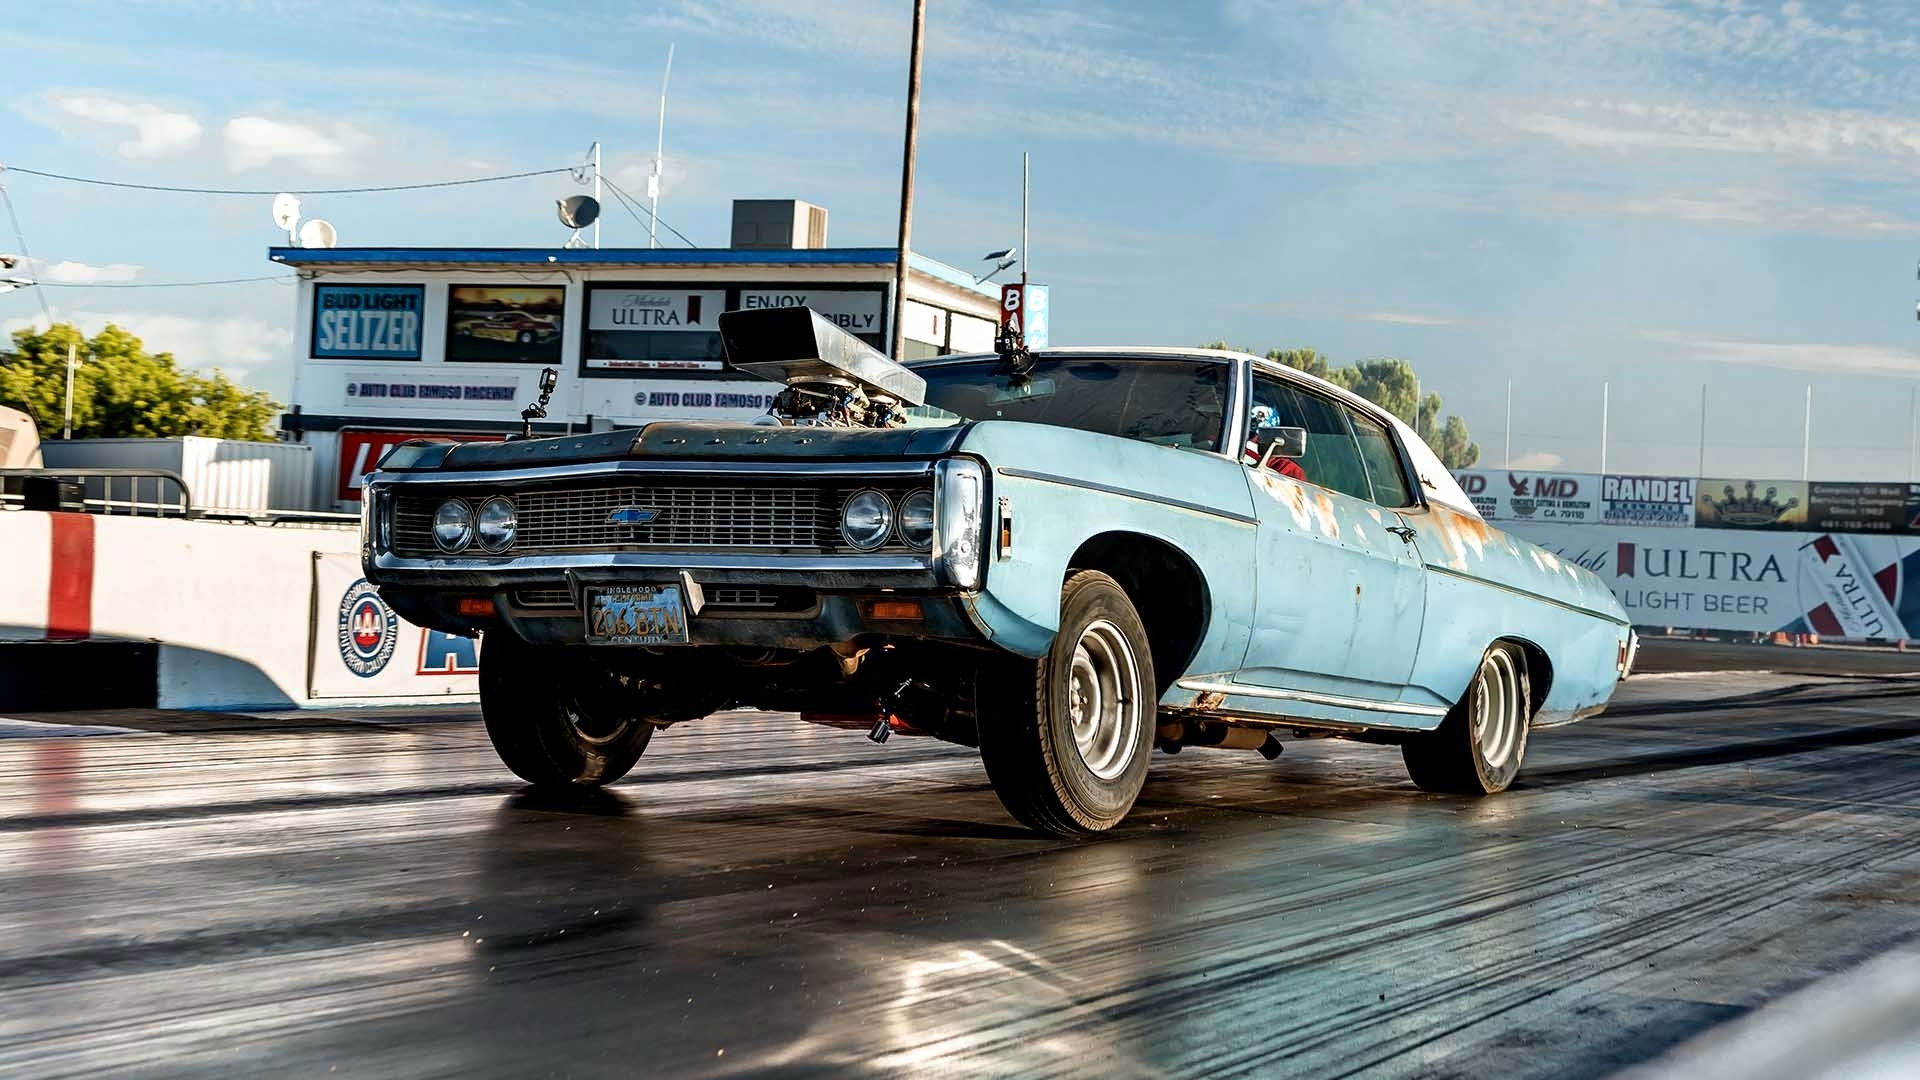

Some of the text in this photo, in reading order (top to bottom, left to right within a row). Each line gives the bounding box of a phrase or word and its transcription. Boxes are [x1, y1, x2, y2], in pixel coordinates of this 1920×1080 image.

[322, 293, 418, 310] BUD LIGHT
[745, 295, 807, 309] ENJOY
[611, 308, 681, 326] ULTRA
[319, 310, 418, 351] SELTZER
[359, 383, 517, 400] AUTO CLUB FAMOSO RACEWAY
[649, 391, 680, 407] AUTO
[681, 392, 712, 407] CLUB
[714, 392, 762, 408] FAMOSO
[1534, 478, 1579, 499] MD
[1603, 477, 1692, 504] RANDEL
[1544, 510, 1557, 518] CA
[1643, 548, 1787, 582] ULTRA
[1625, 590, 1769, 615] LIGHT BEER
[1836, 563, 1883, 637] ULTRA
[592, 607, 628, 636] 206
